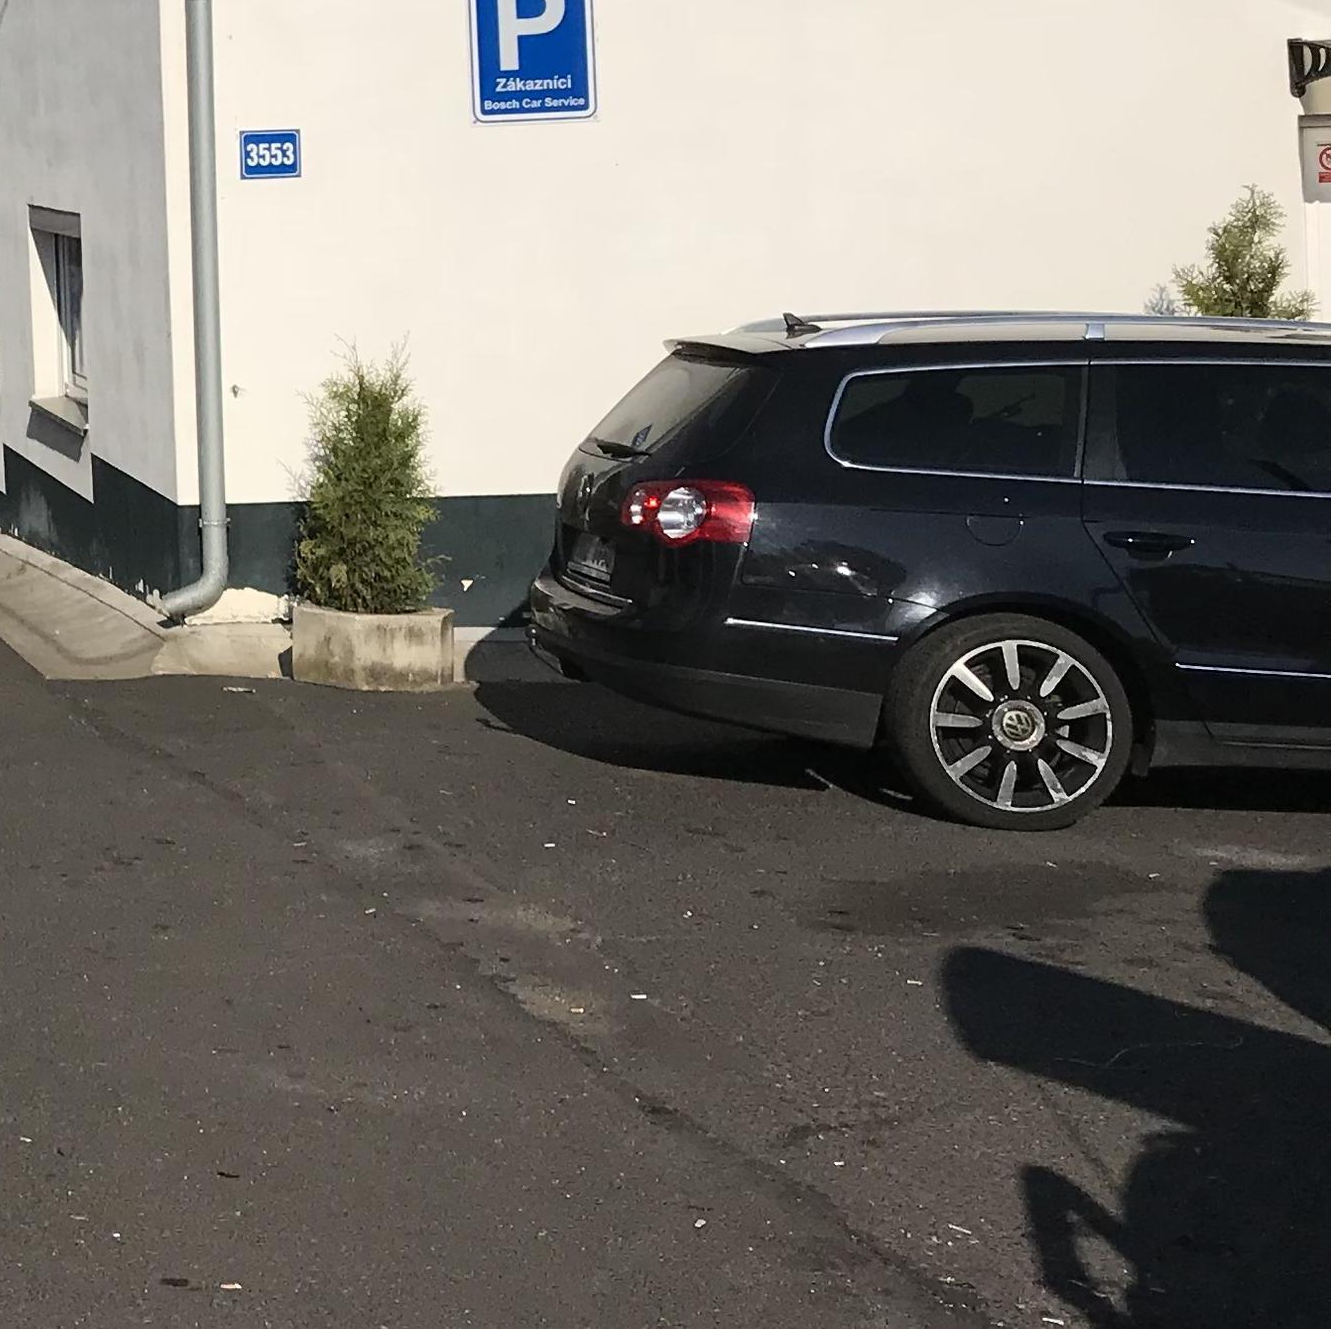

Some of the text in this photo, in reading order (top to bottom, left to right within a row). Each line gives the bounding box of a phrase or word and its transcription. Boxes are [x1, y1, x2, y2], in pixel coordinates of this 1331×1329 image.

[495, 74, 572, 92] Zákazníci
[484, 96, 586, 110] Bosch Car Service
[246, 142, 294, 167] 3553
